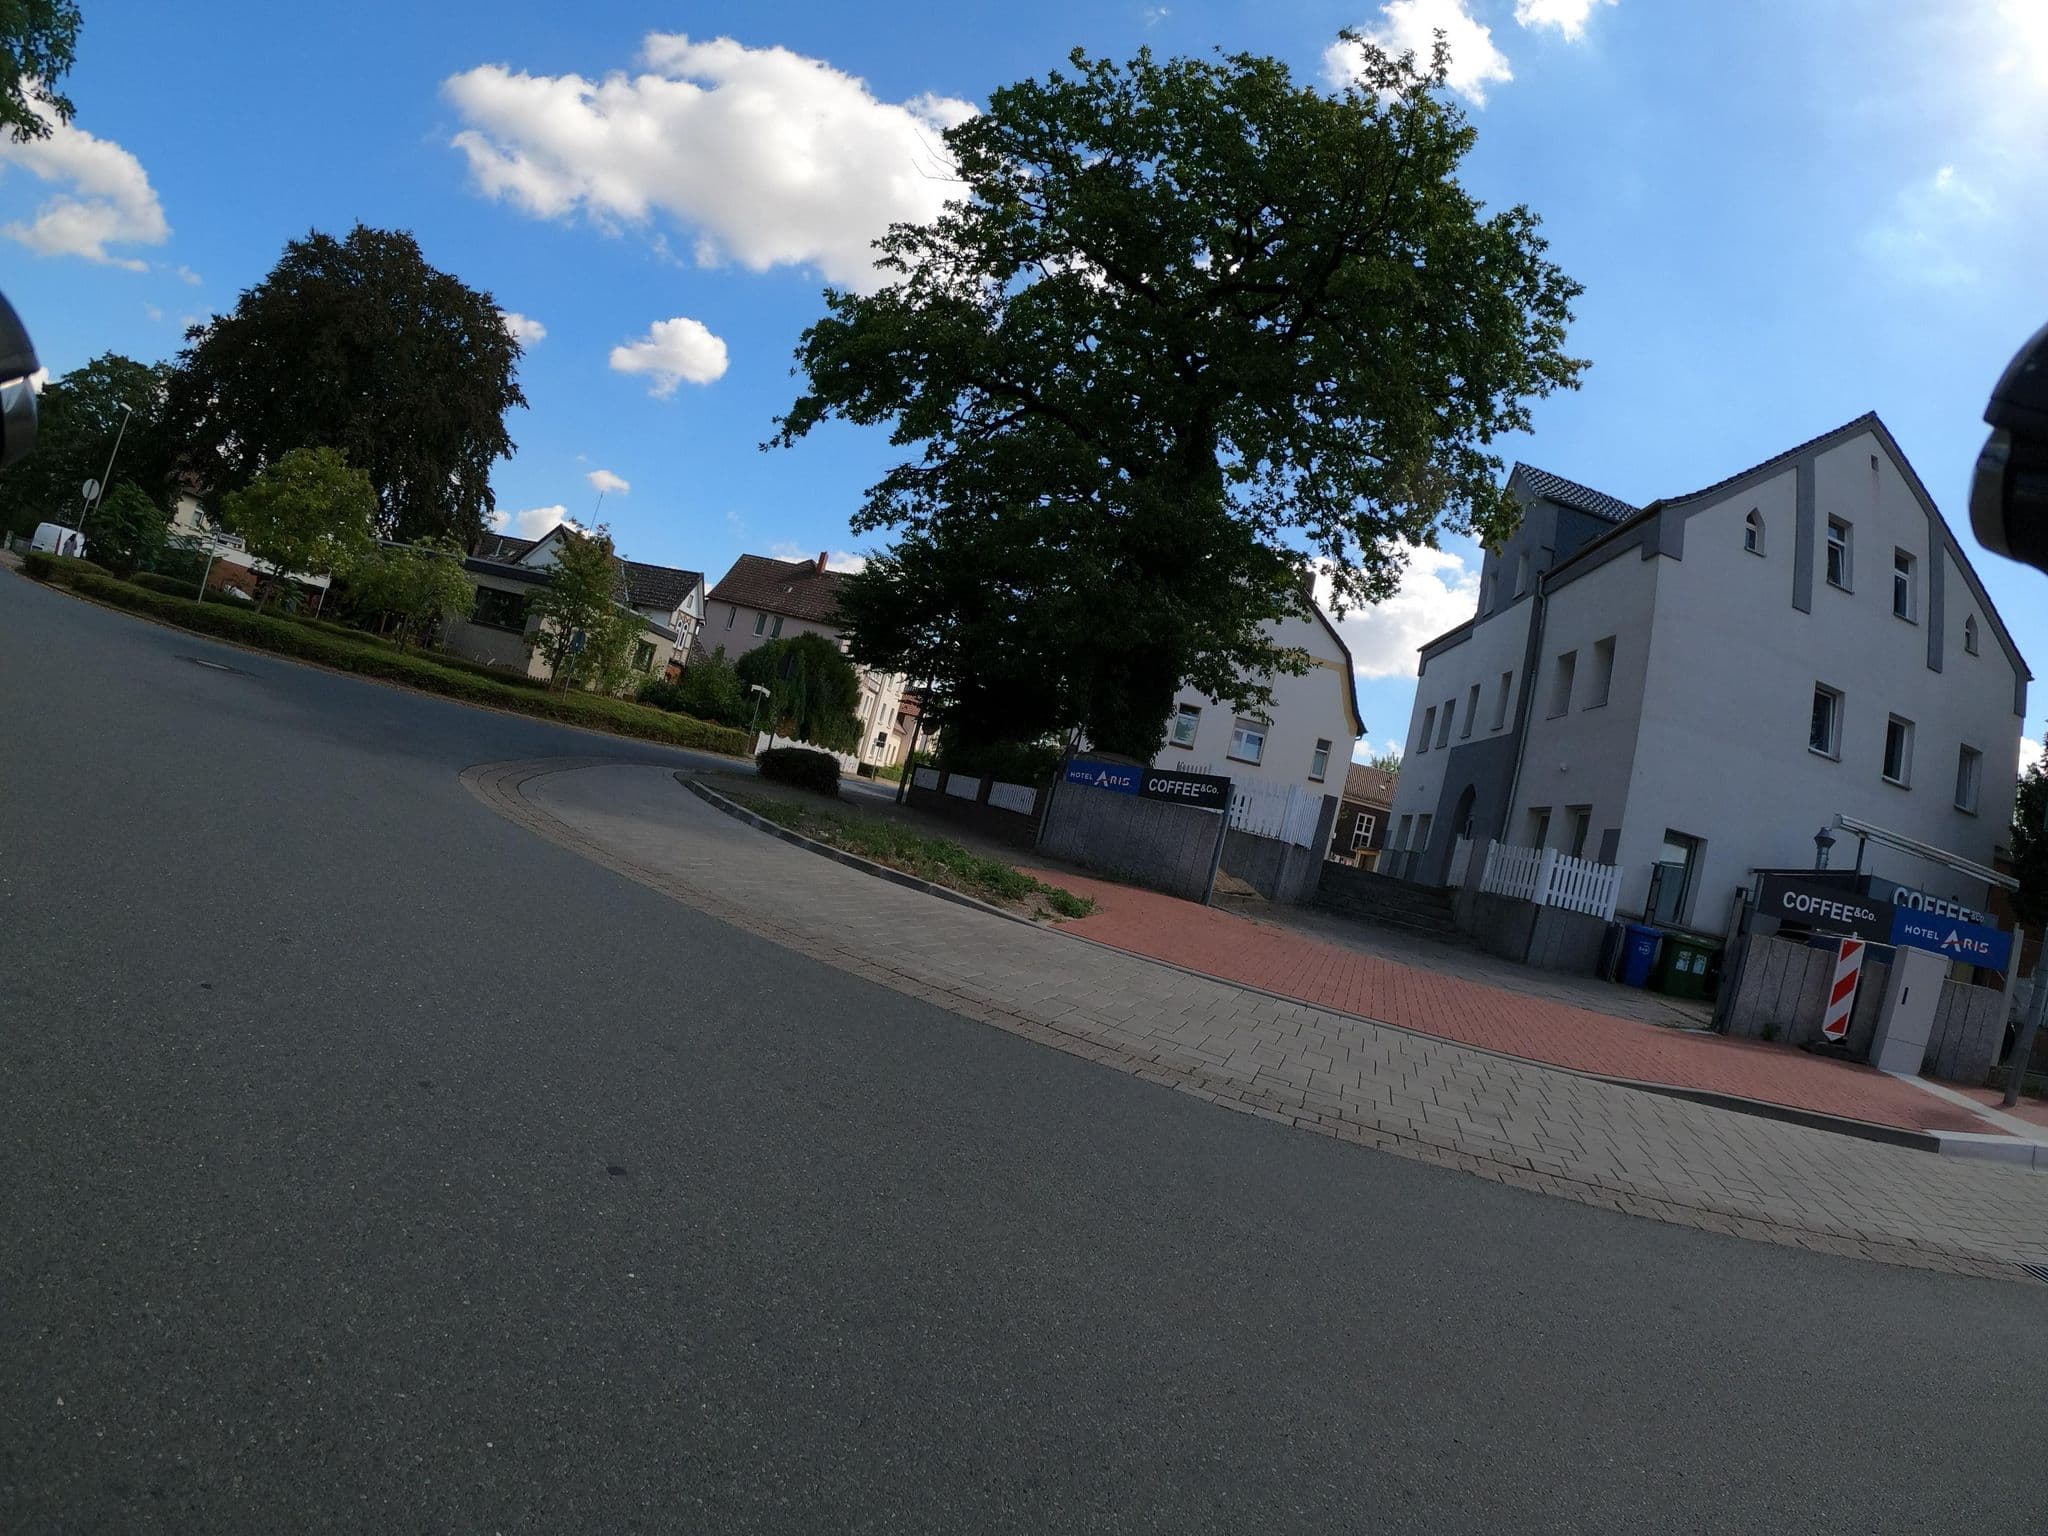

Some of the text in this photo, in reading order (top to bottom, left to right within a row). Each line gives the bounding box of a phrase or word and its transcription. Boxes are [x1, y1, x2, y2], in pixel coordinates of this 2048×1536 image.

[1070, 770, 1130, 787] HOTEL ARIS
[1783, 891, 1877, 922] COFFEE&Co.
[1904, 924, 1989, 953] HOTEL ARIS
